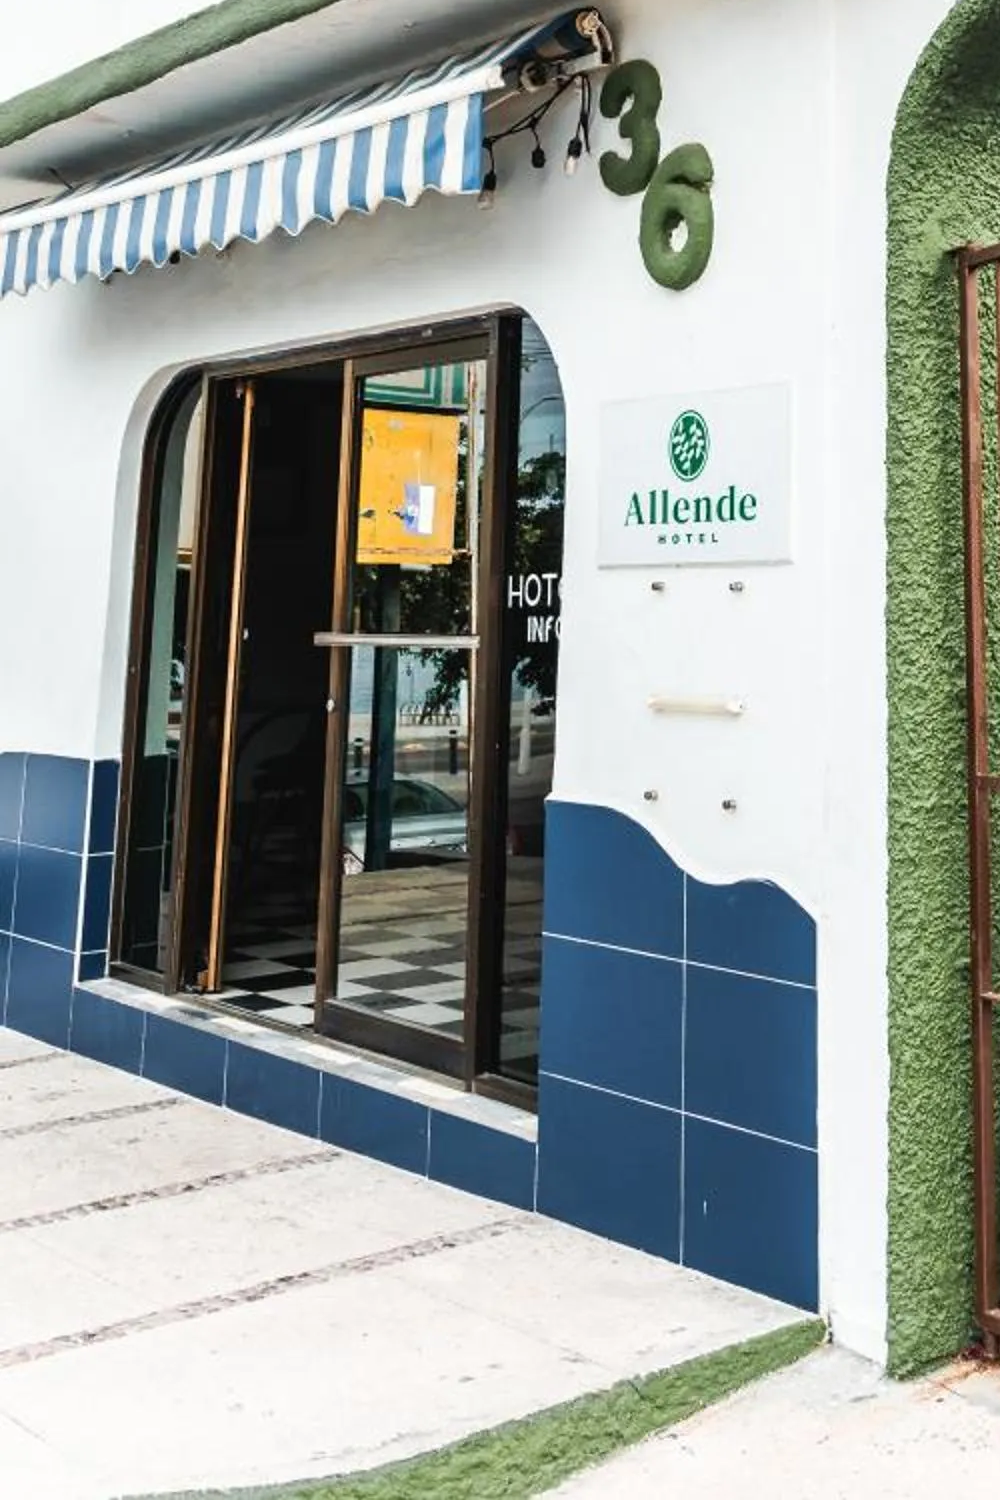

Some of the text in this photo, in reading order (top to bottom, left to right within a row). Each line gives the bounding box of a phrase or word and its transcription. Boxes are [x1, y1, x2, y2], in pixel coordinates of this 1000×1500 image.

[599, 59, 714, 291] 36
[624, 485, 757, 526] Allende
[658, 533, 719, 544] HOTEL
[507, 573, 562, 609] HOT
